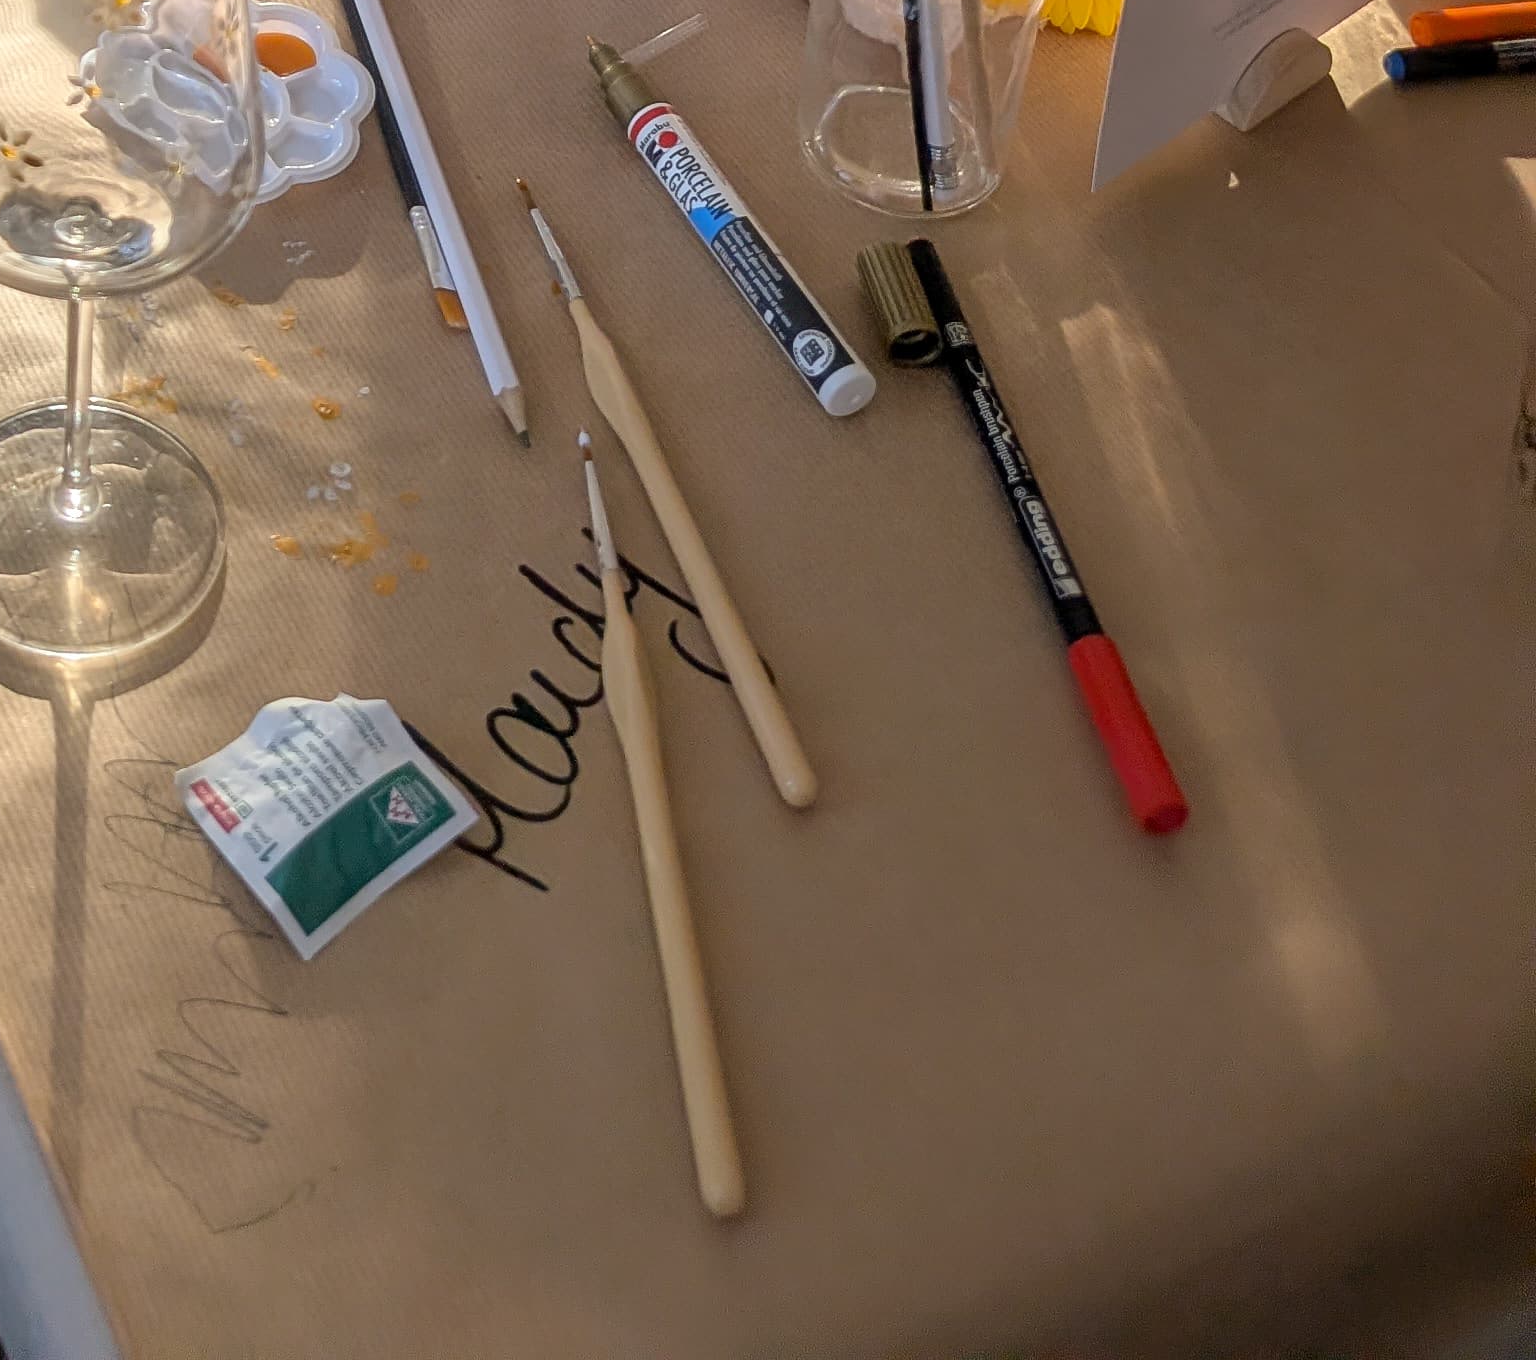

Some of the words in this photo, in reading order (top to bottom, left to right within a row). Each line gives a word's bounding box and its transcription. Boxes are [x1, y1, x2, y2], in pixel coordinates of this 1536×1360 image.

[639, 120, 670, 153] Marabu
[659, 161, 672, 183] &
[669, 176, 697, 214] GLAS
[669, 146, 733, 220] PORCELAIN
[973, 388, 1000, 435] brushpen
[993, 432, 1020, 484] Porcelain
[1027, 501, 1069, 576] edding
